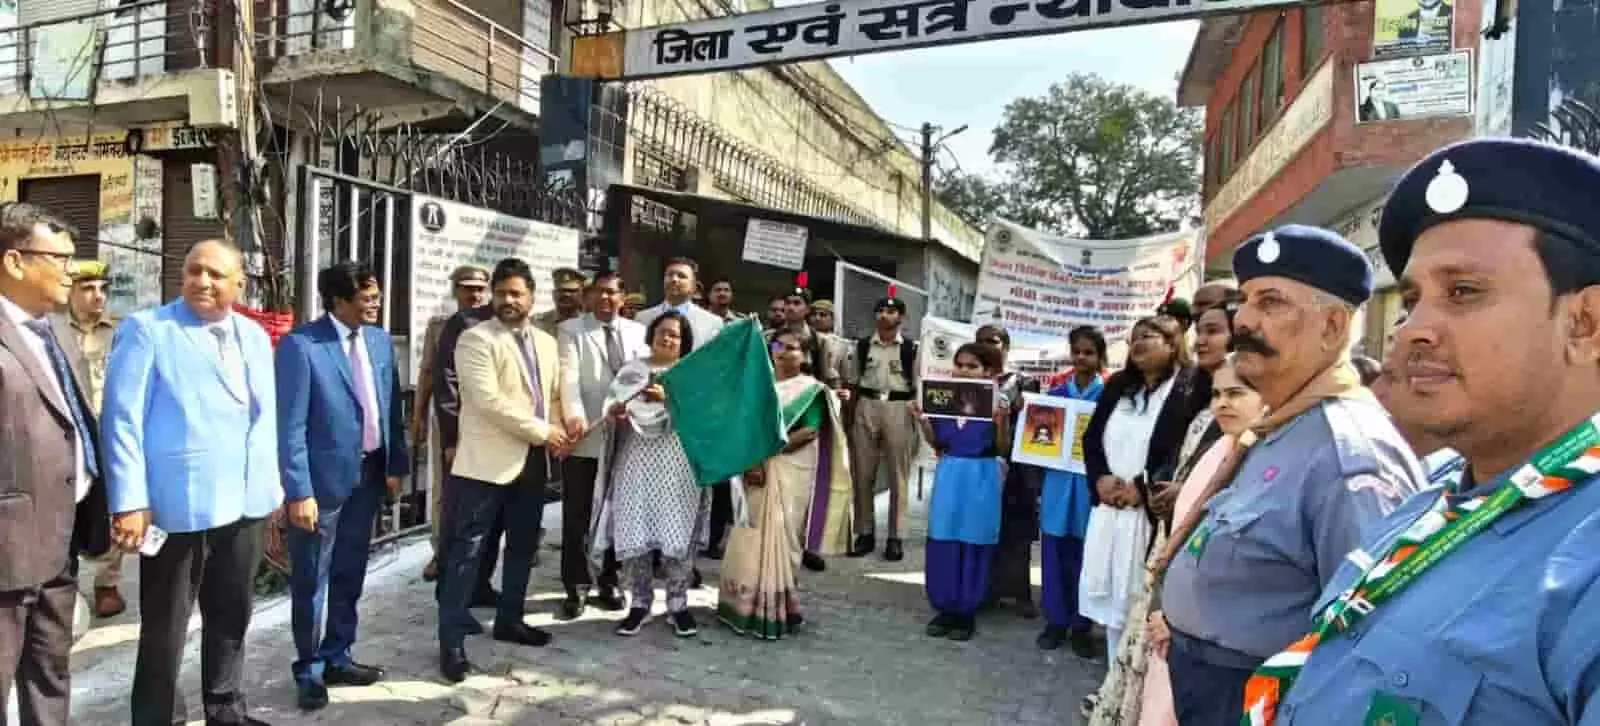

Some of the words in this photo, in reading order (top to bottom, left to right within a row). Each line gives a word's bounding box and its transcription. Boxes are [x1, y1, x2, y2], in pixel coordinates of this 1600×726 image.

[653, 28, 735, 66] जिला
[743, 5, 846, 53] एवं
[858, 0, 968, 41] सत्र
